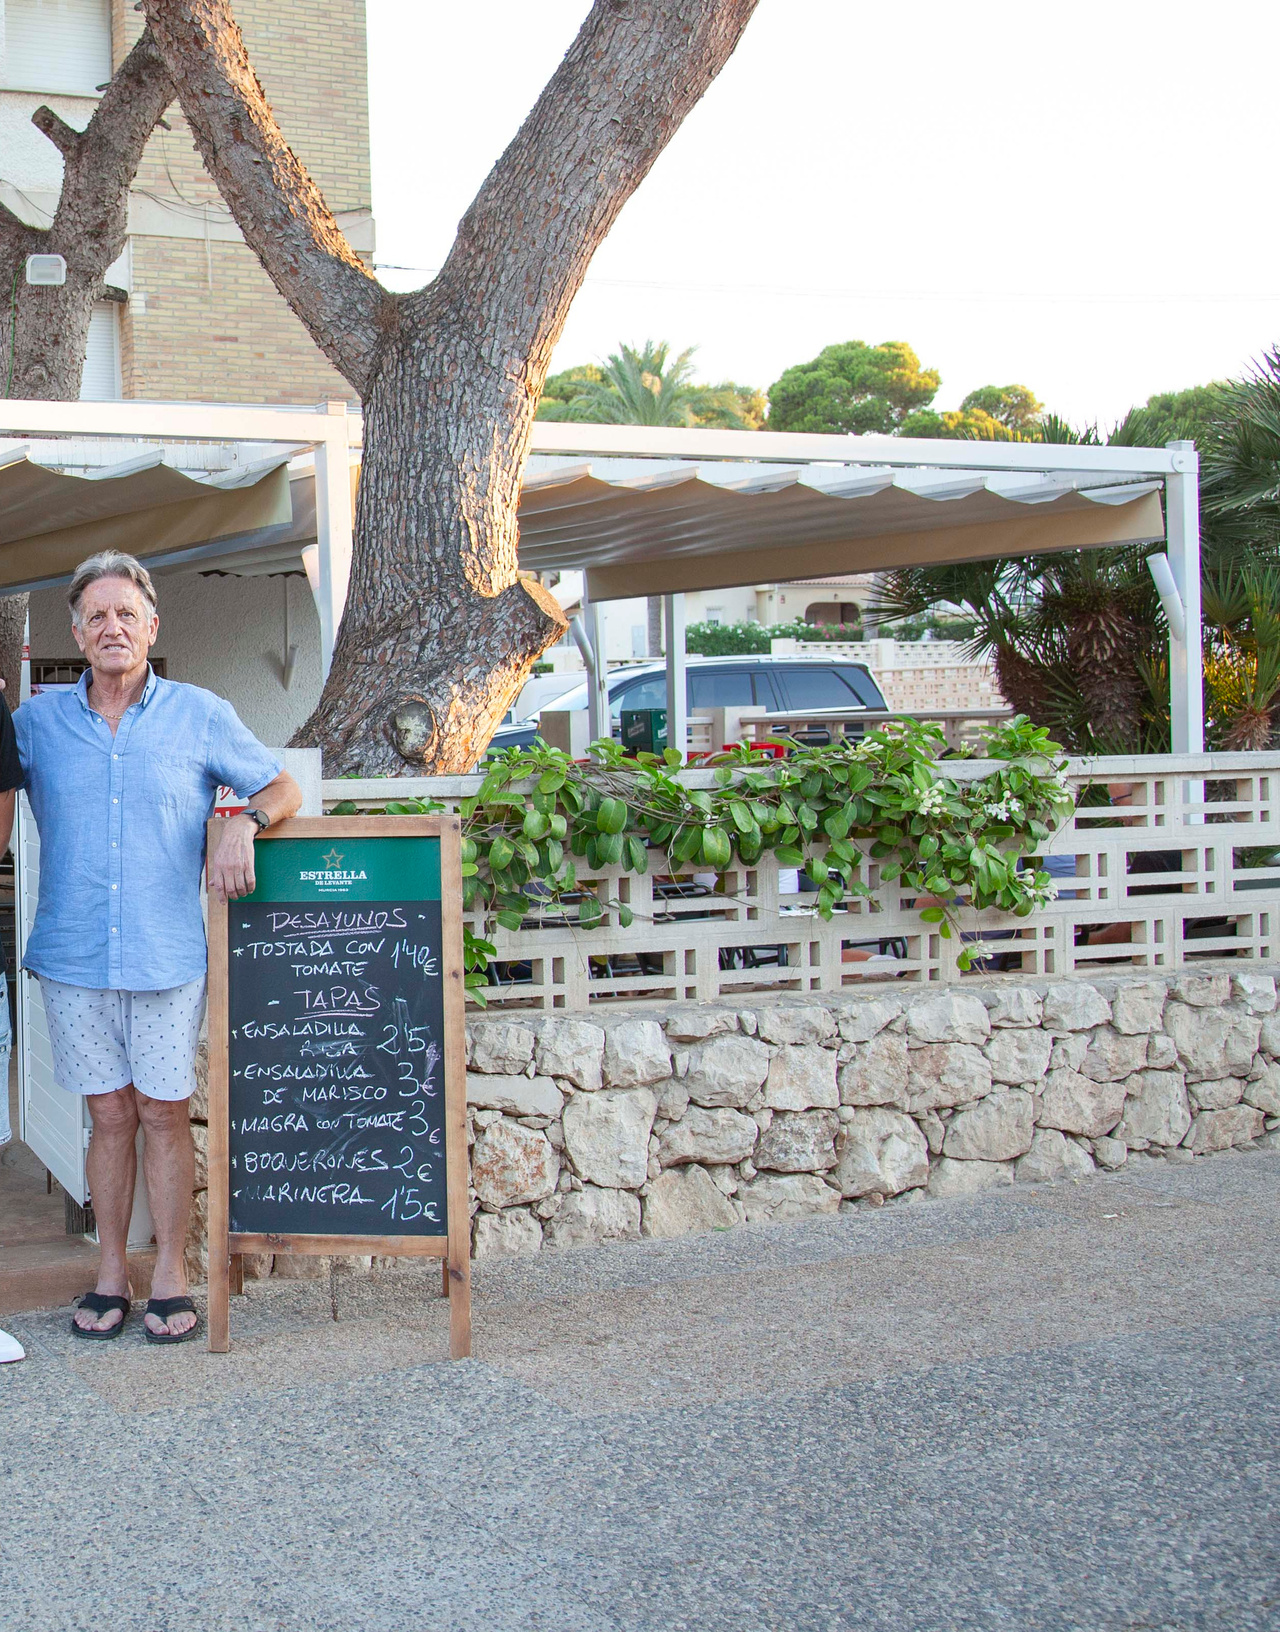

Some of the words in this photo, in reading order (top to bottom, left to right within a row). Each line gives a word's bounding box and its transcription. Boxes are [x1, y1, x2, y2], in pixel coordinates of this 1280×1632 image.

[299, 870, 368, 880] ESTRELLA
[266, 908, 407, 932] DESAYUNOS
[247, 940, 334, 959] TOSTADA
[346, 938, 386, 954] CON
[291, 961, 368, 977] TOMATE
[294, 986, 381, 1010] TAPAS
[241, 1021, 366, 1039] ENSALADILLA
[263, 1087, 288, 1104] DE
[302, 1085, 388, 1102] MARISCO
[241, 1113, 309, 1135] MAGRA
[343, 1110, 407, 1131] TOMATE
[244, 1149, 389, 1173] BOQUERONES
